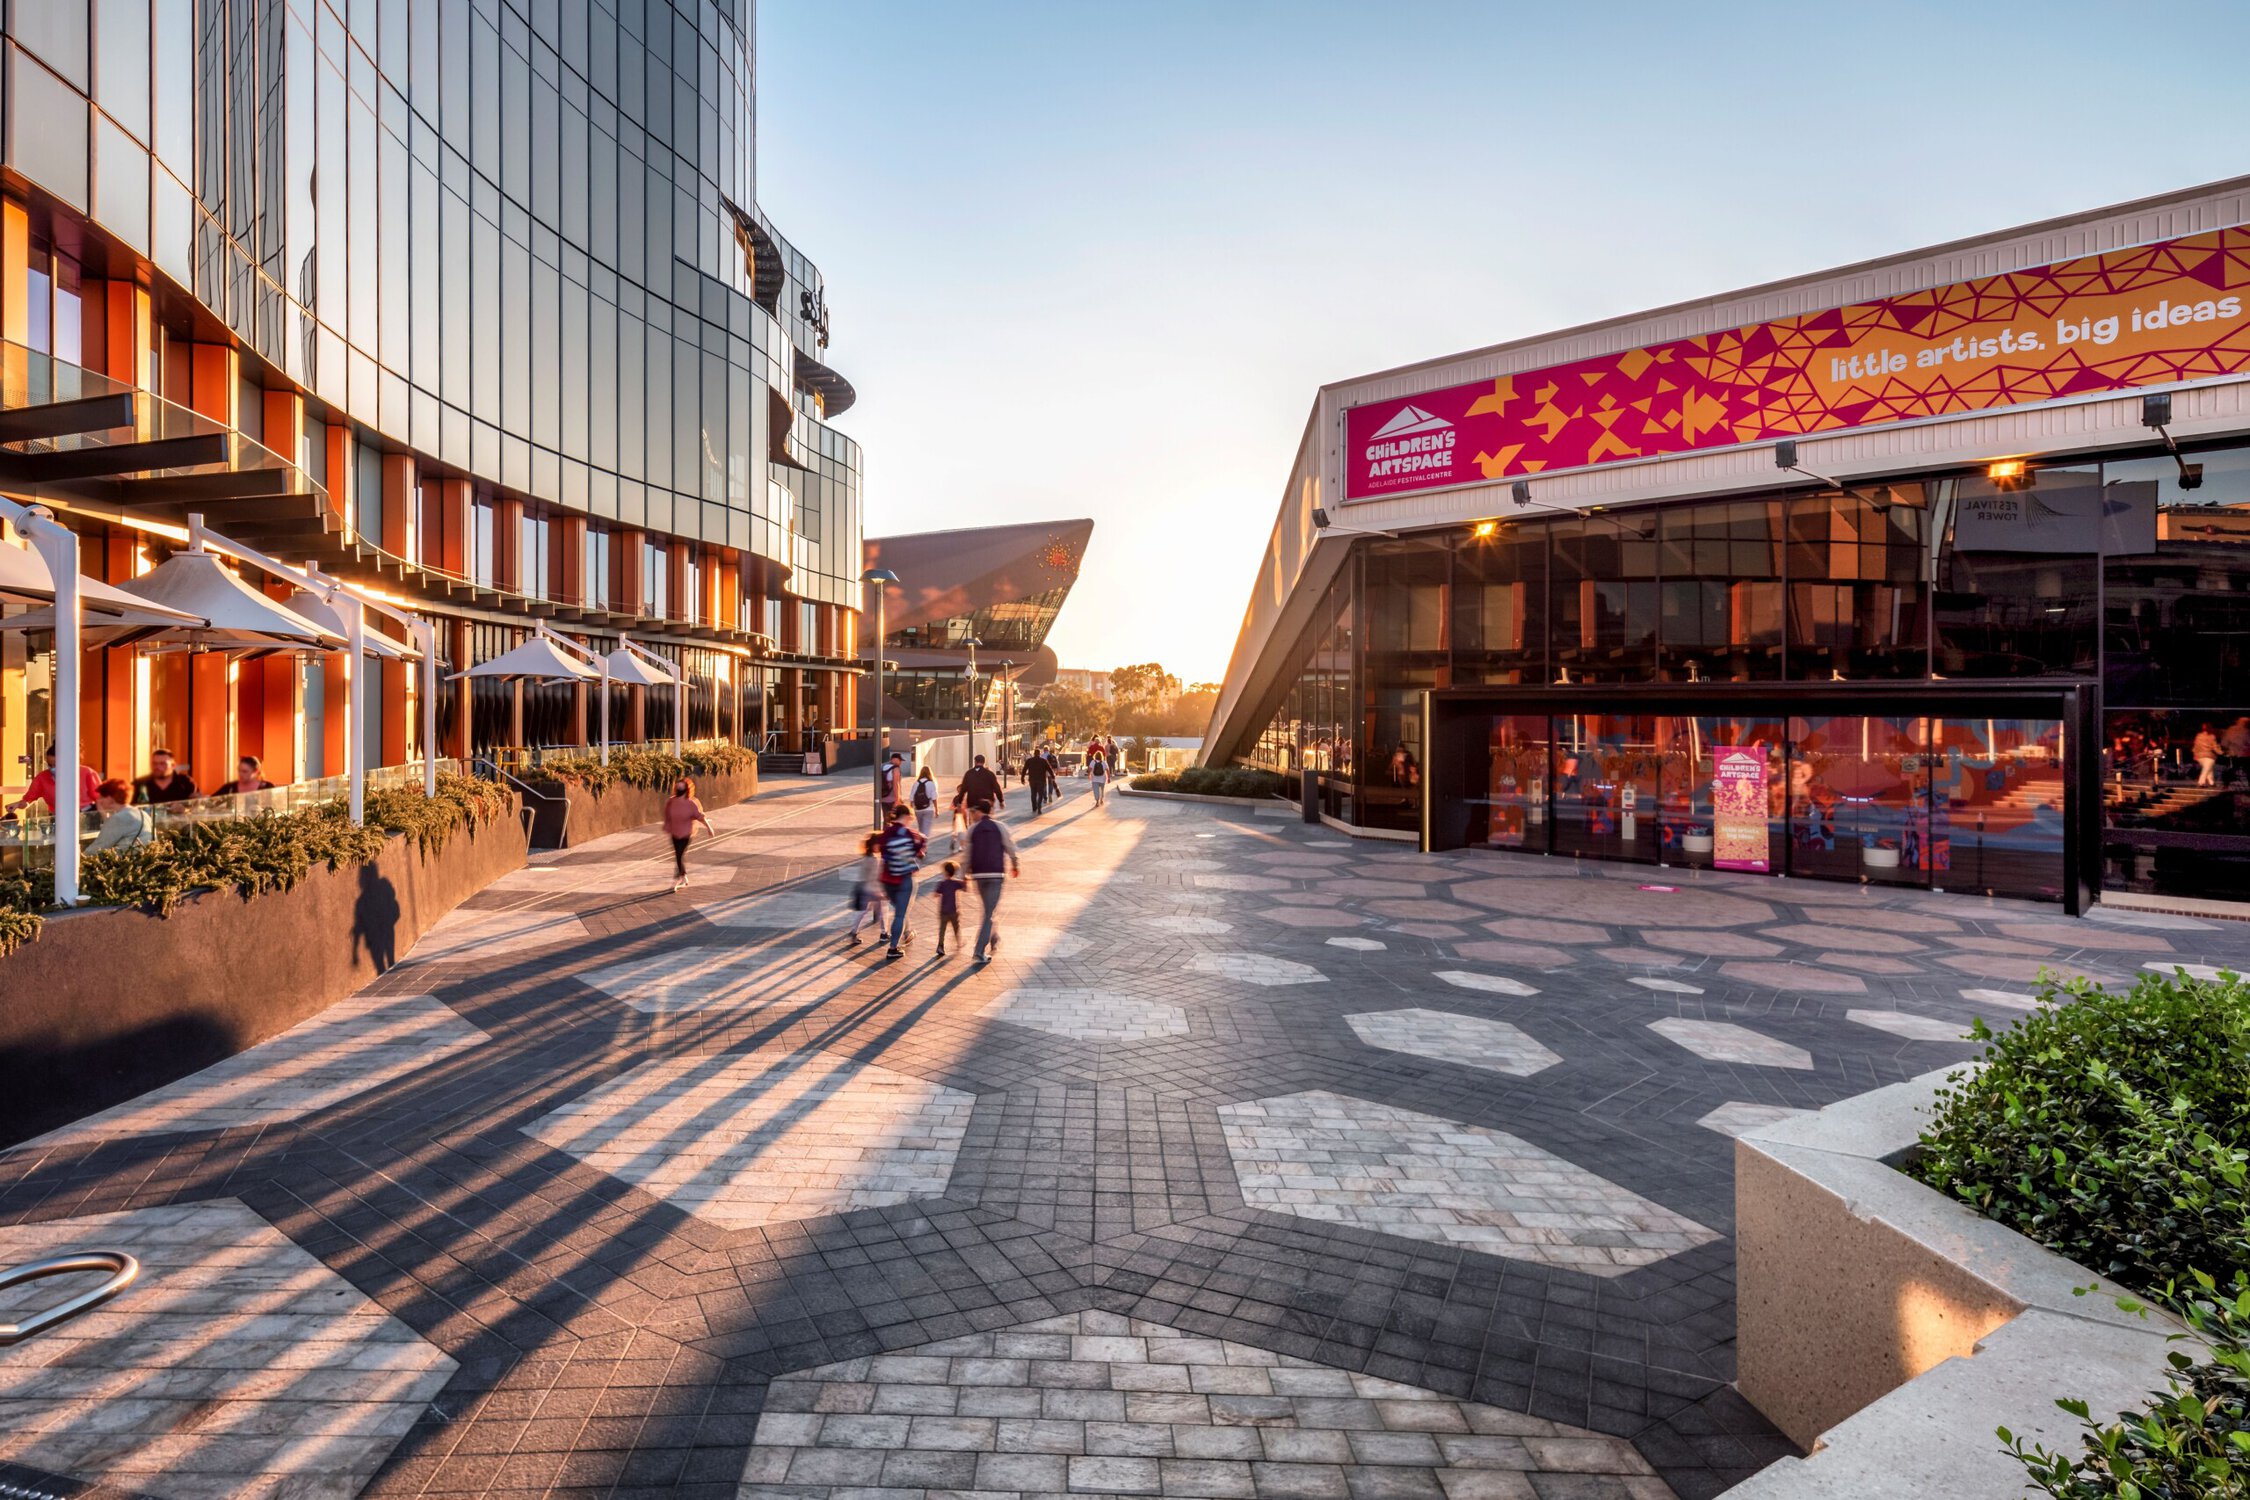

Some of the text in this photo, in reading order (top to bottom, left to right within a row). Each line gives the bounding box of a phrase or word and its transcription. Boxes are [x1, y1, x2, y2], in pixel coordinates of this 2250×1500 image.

[1830, 348, 1908, 383] little
[2056, 312, 2120, 346] big
[2131, 296, 2242, 333] ideas
[1368, 450, 1452, 478] ARTSPACE
[1368, 470, 1453, 489] ADELAIDE FESTIVAL CENTRE
